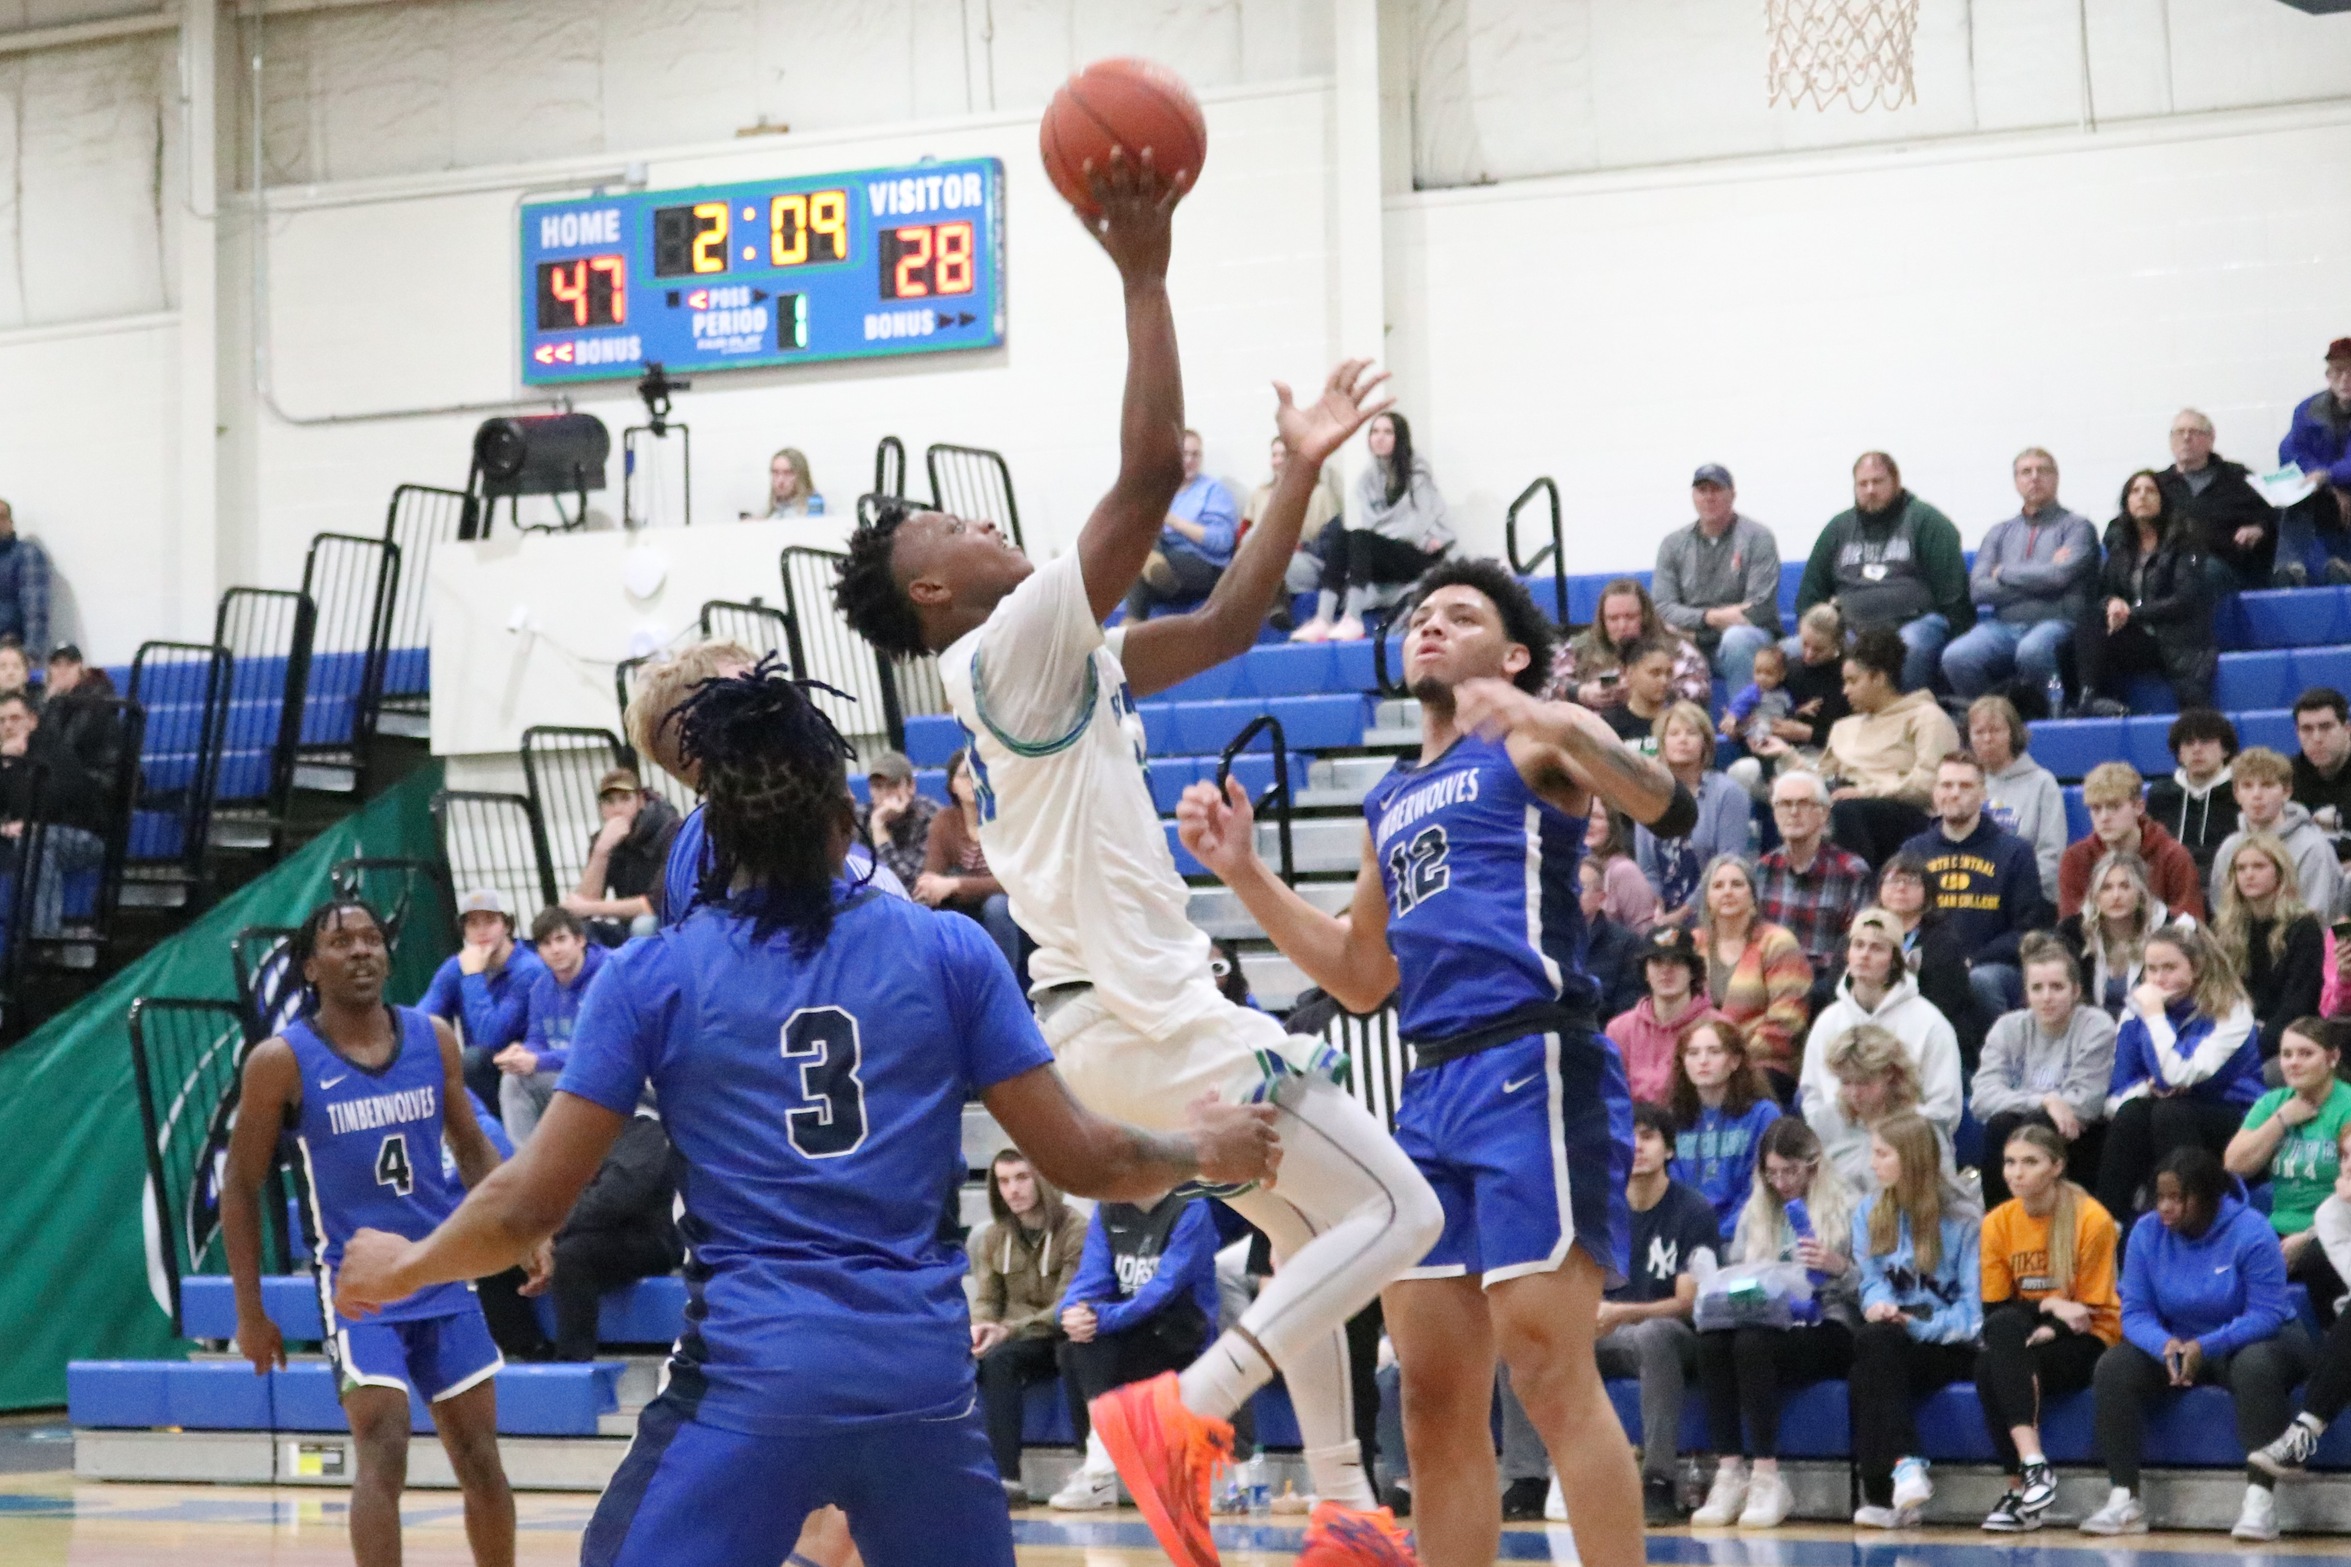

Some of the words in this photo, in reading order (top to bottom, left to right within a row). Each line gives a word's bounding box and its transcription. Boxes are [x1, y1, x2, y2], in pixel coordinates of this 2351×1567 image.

[869, 173, 982, 216] VISITOR
[541, 210, 621, 248] HOME
[692, 189, 847, 273] 2:09
[895, 221, 974, 298] 28
[551, 254, 625, 327] 47
[692, 306, 768, 338] PERIOD
[794, 293, 808, 348] 1
[865, 310, 935, 340] BONUS
[575, 337, 641, 365] BONUS
[1389, 824, 1450, 919] 12
[780, 1005, 869, 1160] 3
[326, 1085, 435, 1135] TIMBERWOLVES
[375, 1133, 413, 1196] 4
[1647, 1235, 1678, 1279] NY
